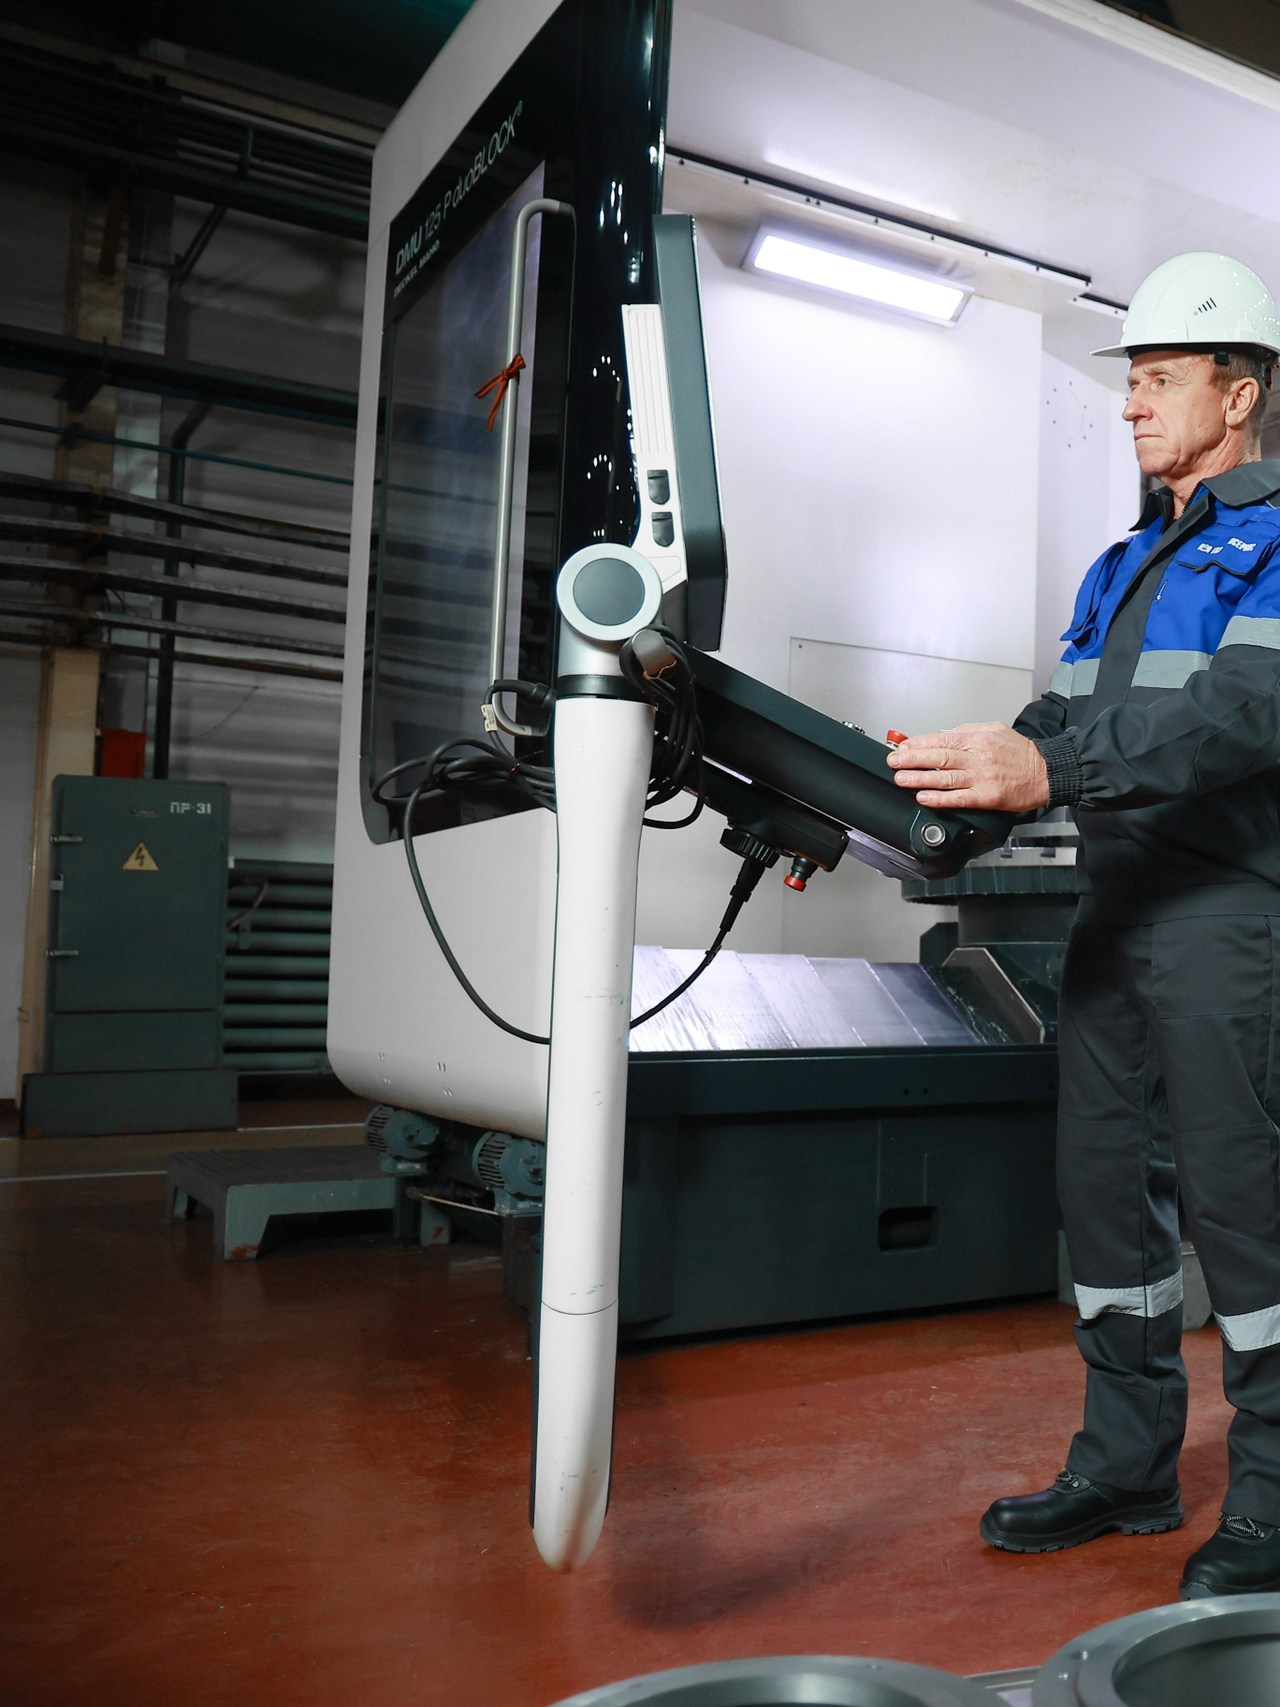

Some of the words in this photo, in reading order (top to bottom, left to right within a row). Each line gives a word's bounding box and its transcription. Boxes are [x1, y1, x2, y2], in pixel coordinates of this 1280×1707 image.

[396, 225, 422, 276] DMU
[425, 202, 441, 241] 125
[443, 190, 452, 220] P
